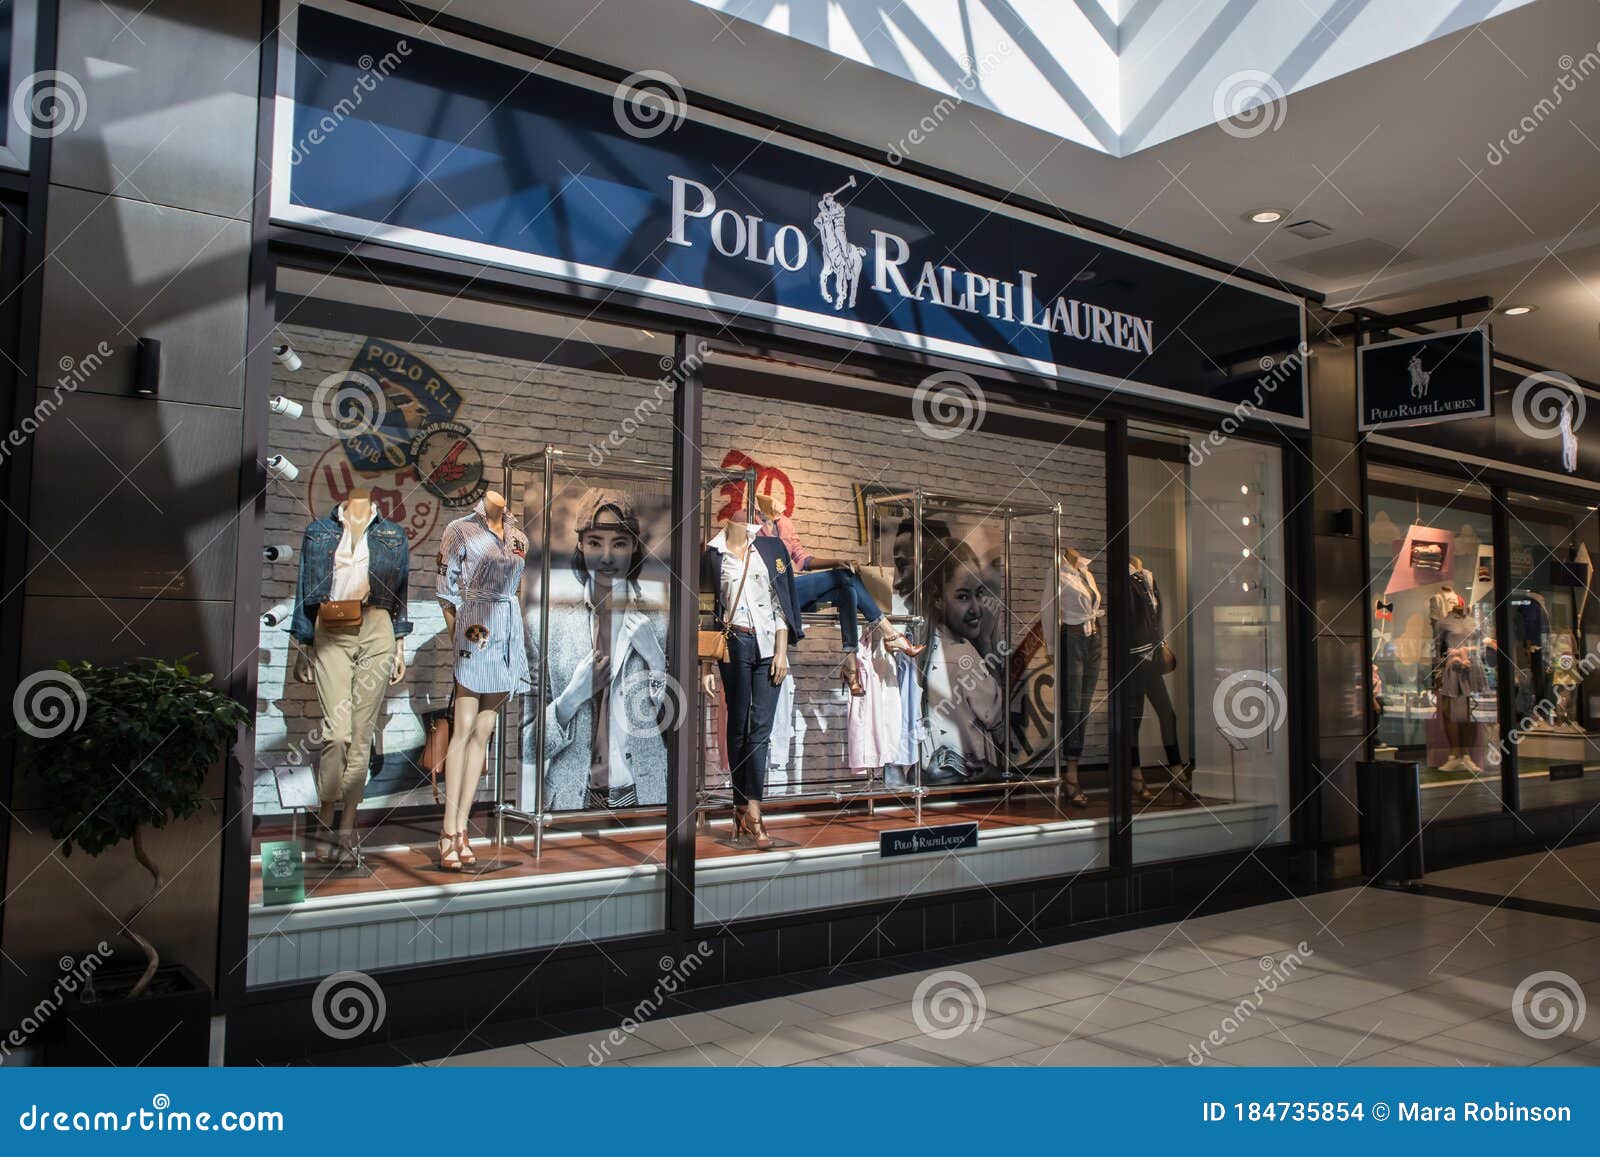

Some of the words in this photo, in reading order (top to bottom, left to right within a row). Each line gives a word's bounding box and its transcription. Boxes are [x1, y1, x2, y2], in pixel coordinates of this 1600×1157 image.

[665, 175, 808, 271] POLO
[871, 230, 1015, 322] RALPH
[1018, 270, 1154, 356] LAUREN
[367, 345, 423, 382] POLO
[1371, 408, 1397, 421] POLO
[1399, 404, 1432, 417] RALPH
[1433, 399, 1476, 413] LAUREN
[347, 437, 381, 464] CLUB
[894, 840, 912, 851] POLO
